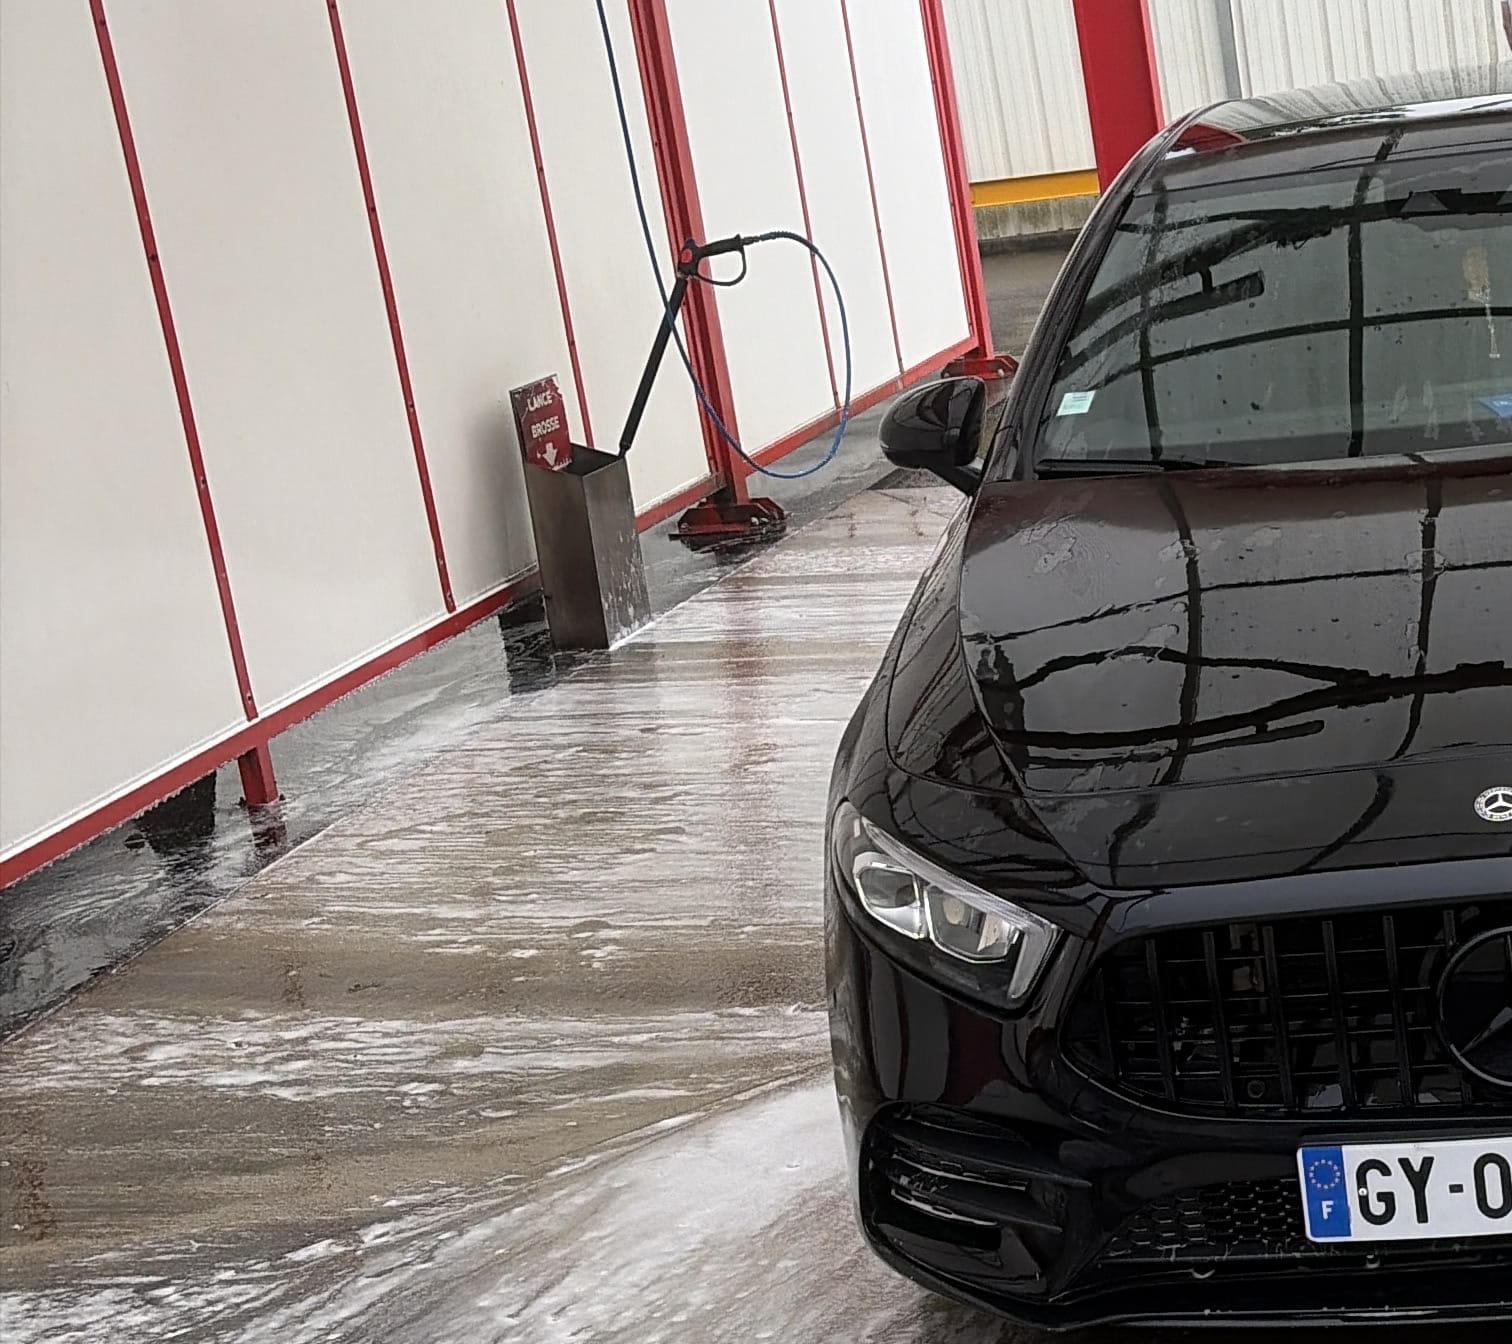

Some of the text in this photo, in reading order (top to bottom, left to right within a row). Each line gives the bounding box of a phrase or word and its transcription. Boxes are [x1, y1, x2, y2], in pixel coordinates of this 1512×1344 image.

[527, 390, 554, 413] LANCE
[530, 414, 561, 439] BROSSE
[1321, 1200, 1334, 1221] F
